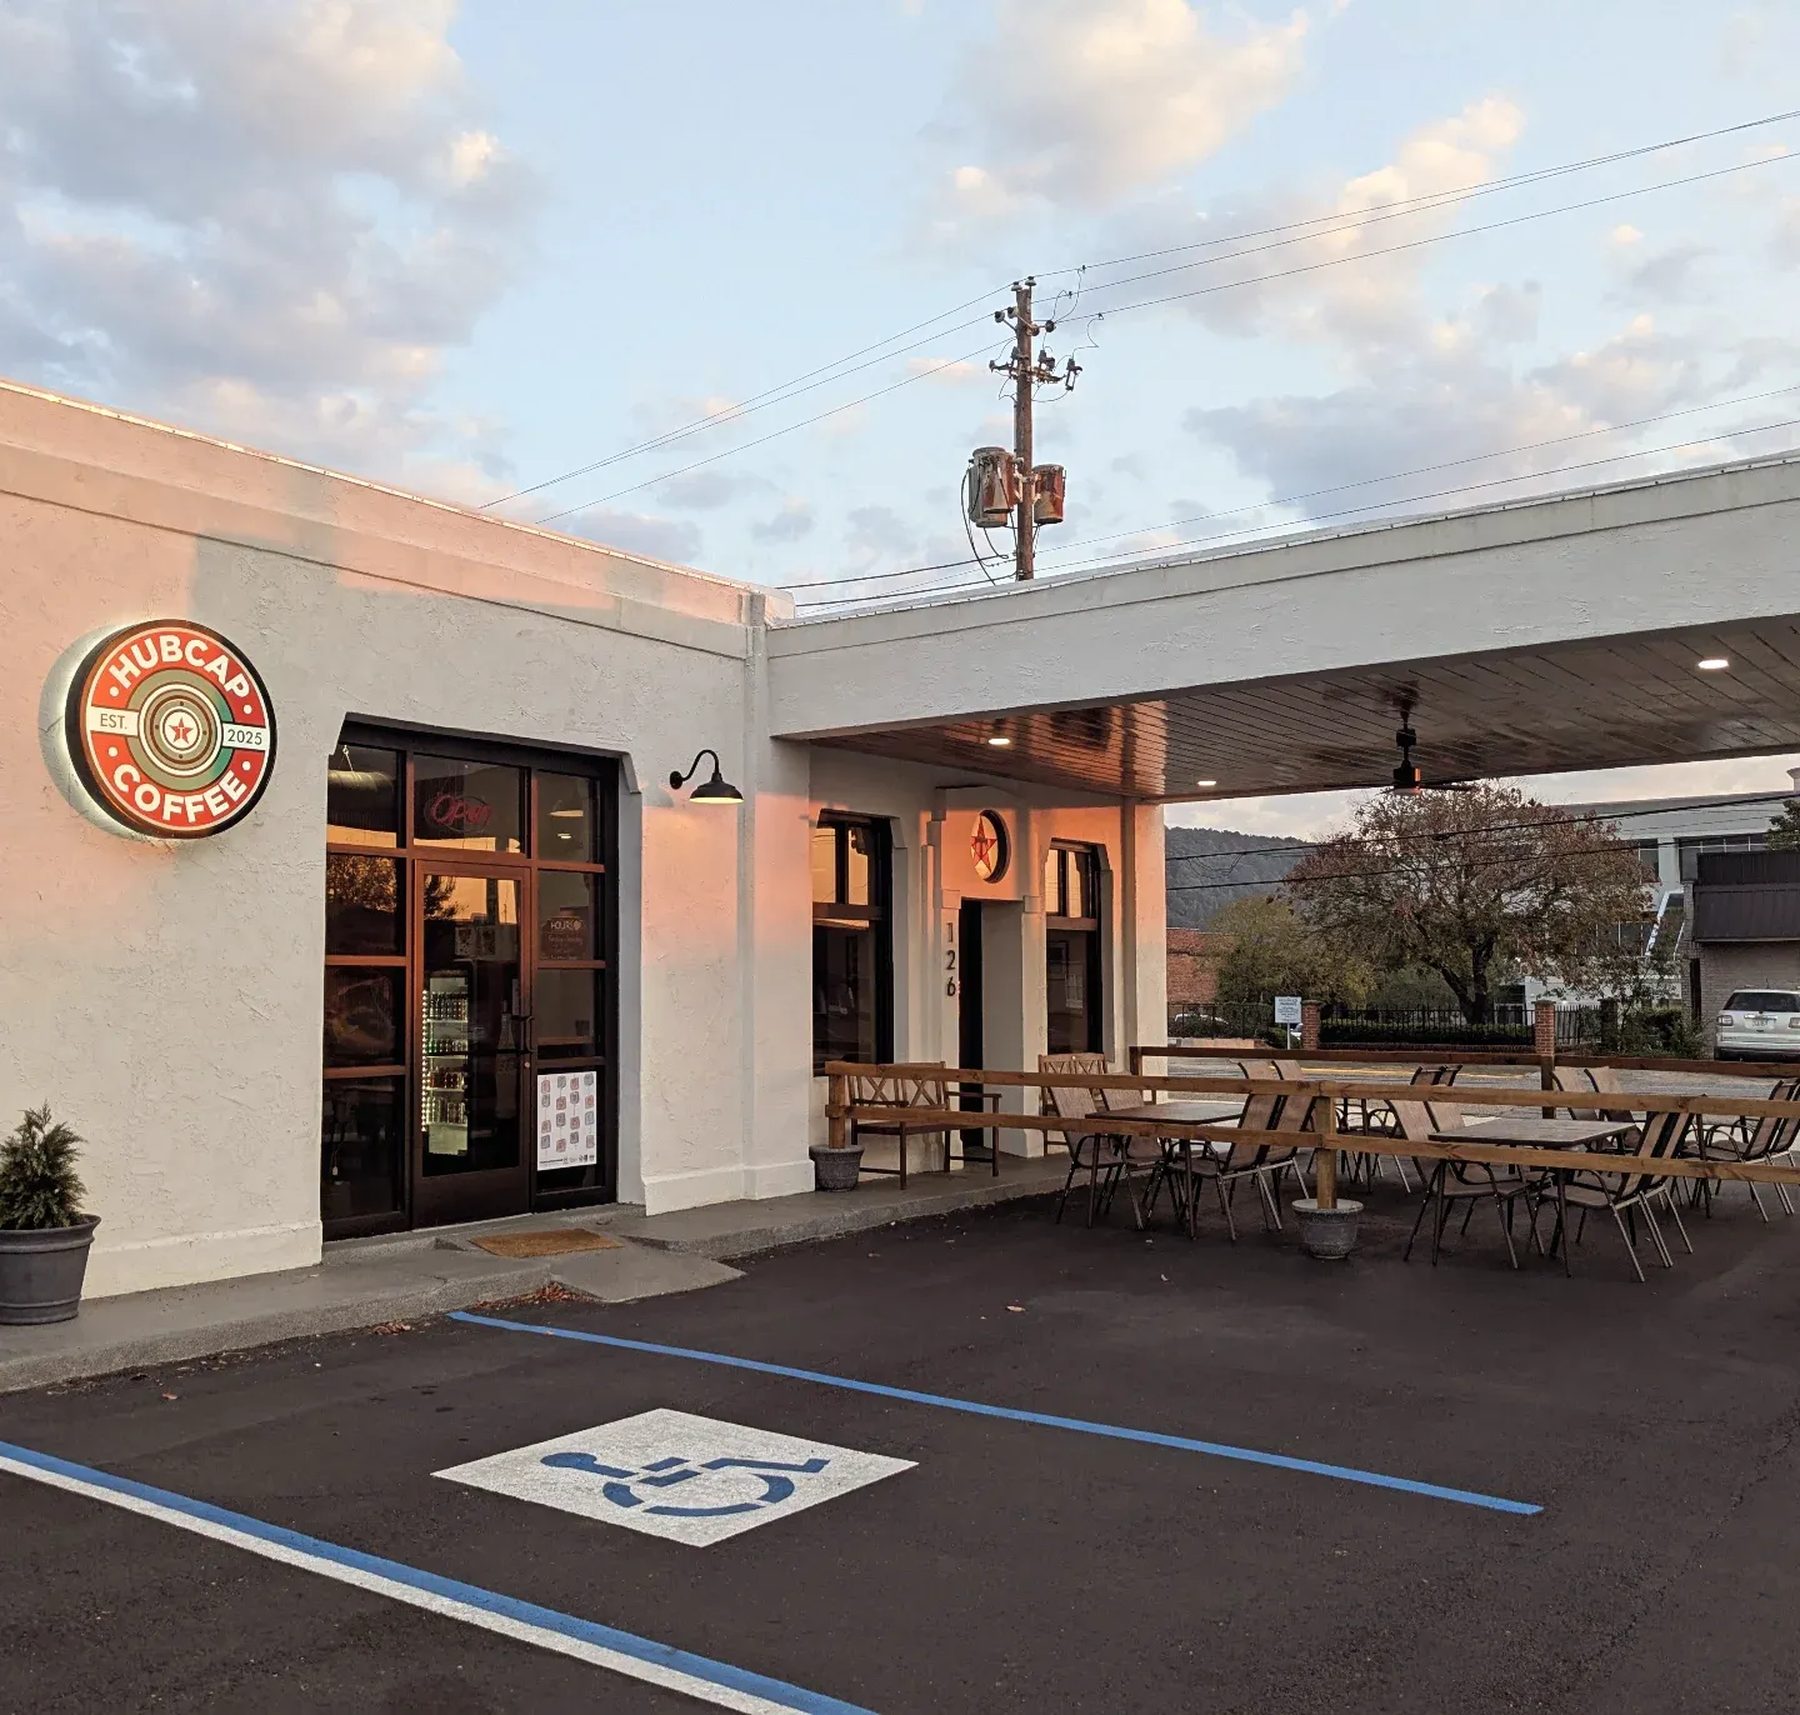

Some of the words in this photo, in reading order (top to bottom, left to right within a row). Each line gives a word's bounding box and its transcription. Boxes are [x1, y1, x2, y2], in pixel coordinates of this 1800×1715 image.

[109, 635, 249, 698] HUBCAP
[100, 713, 127, 730] EST.
[227, 729, 263, 745] 2025
[113, 764, 247, 823] COFFEE
[946, 922, 956, 996] 126
